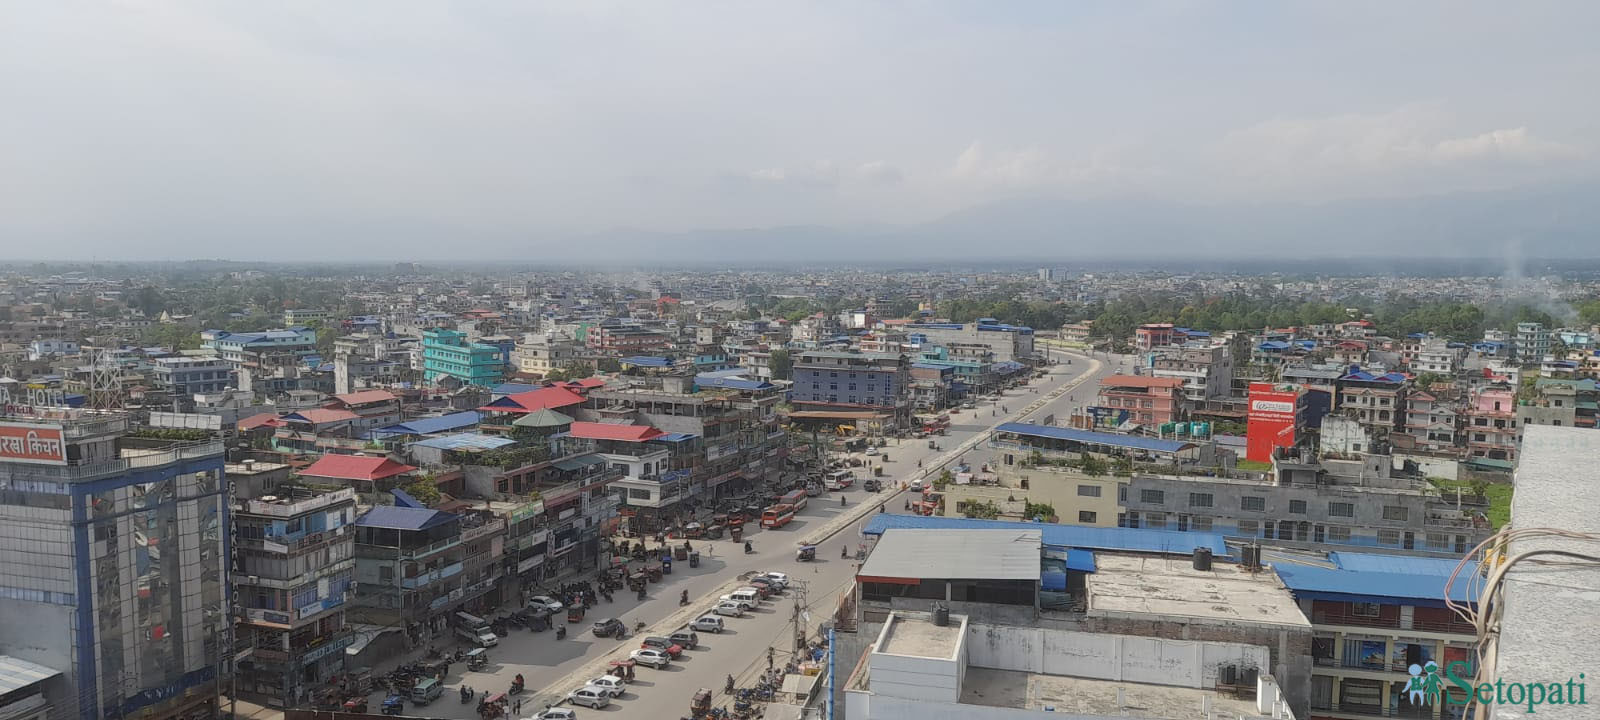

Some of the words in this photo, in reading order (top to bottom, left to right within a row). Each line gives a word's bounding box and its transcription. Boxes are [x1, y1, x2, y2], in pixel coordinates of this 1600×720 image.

[0, 435, 25, 455] रखा
[27, 430, 61, 457] किचन
[228, 481, 239, 573] GORAKHA
